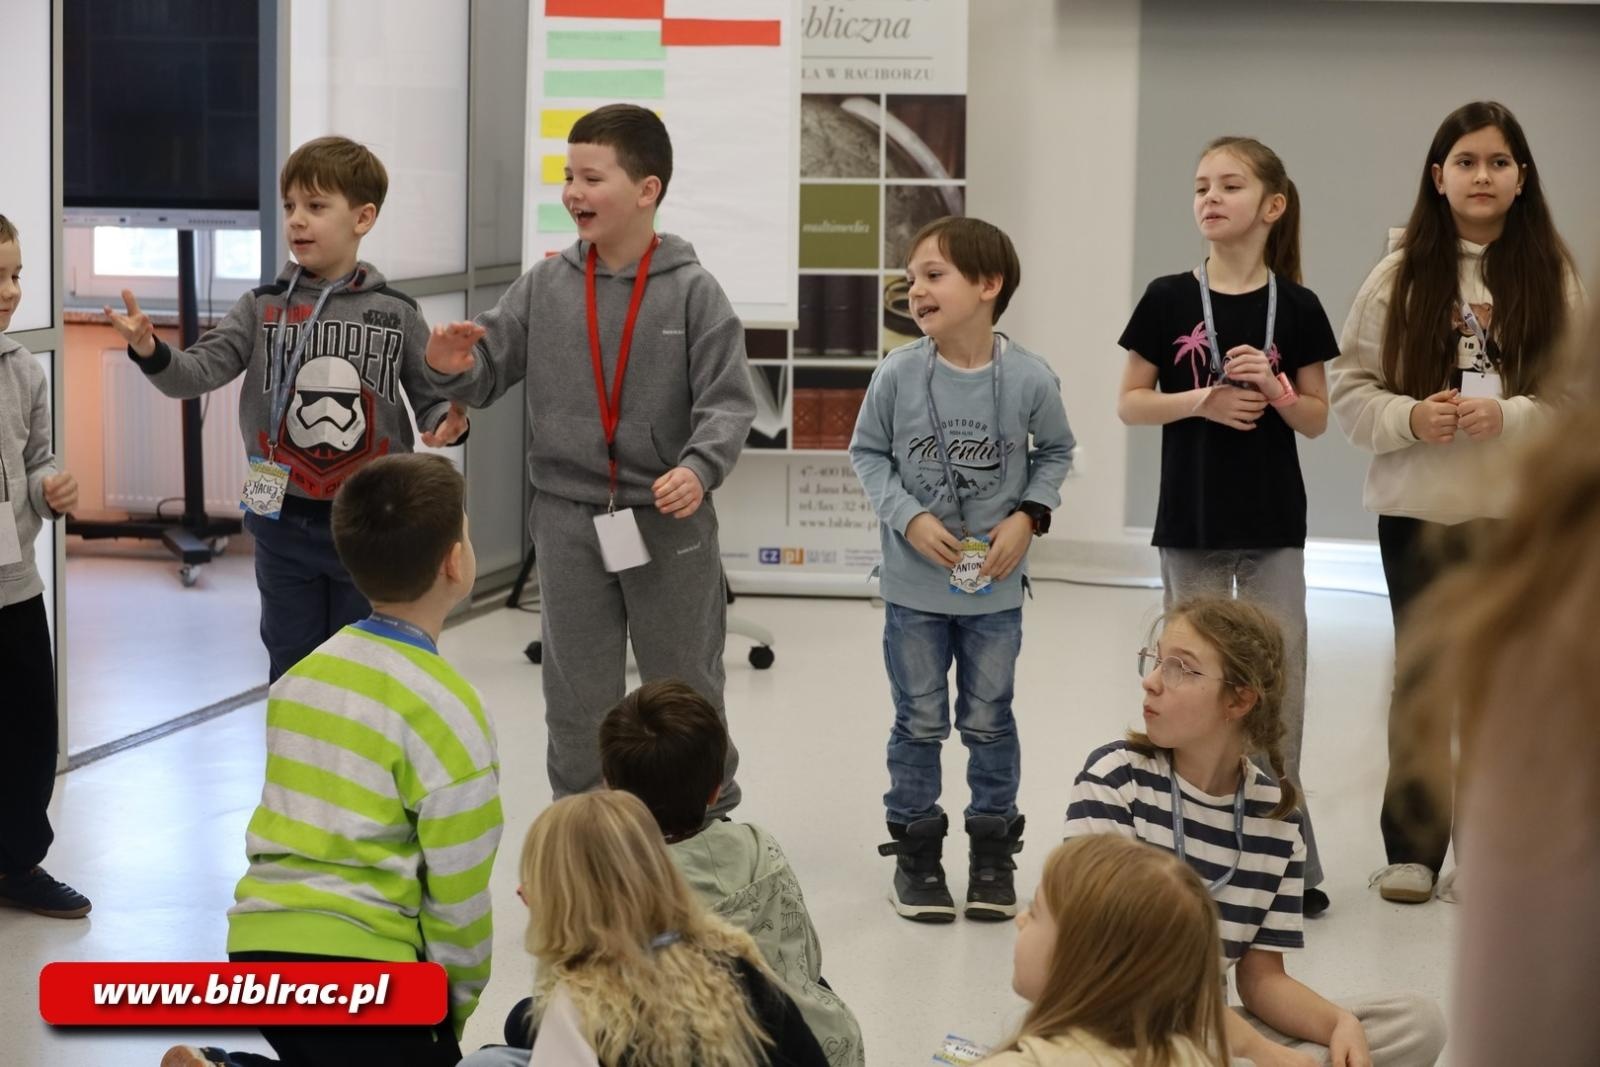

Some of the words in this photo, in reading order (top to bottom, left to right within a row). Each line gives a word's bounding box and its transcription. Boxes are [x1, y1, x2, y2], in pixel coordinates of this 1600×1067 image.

[801, 5, 911, 43] bliczna
[825, 68, 837, 79] W
[844, 68, 934, 81] RACIBORZU
[941, 418, 989, 432] OUTDOOR
